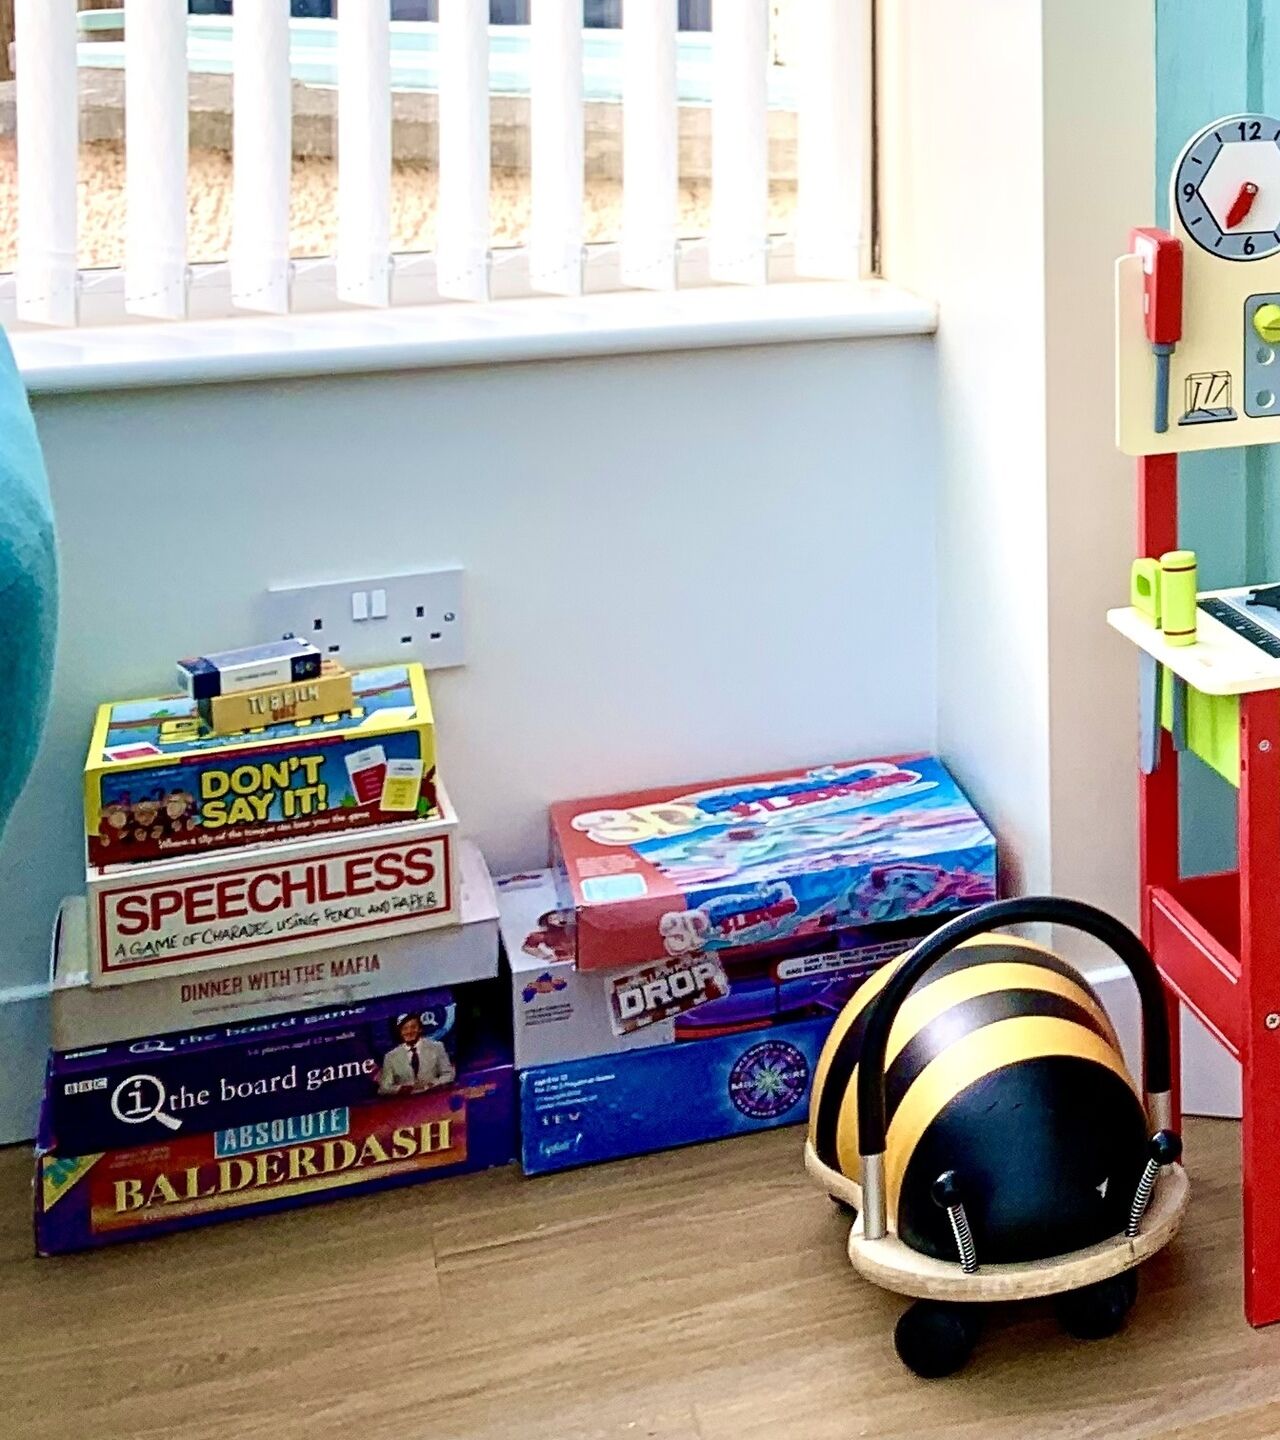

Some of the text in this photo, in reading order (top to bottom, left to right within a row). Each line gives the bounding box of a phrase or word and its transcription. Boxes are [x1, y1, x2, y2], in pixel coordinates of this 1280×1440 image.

[1238, 121, 1262, 141] 12
[1183, 183, 1195, 202] 9
[1243, 237, 1255, 255] 6
[202, 754, 325, 799] DON'T
[202, 783, 328, 829] SAY IT!
[115, 847, 435, 936] SPEECHLESS
[114, 942, 126, 958] A
[129, 935, 178, 957] GAME
[202, 920, 275, 946] CHARADES
[276, 911, 321, 933] USING
[323, 906, 366, 923] PENCIL
[368, 899, 390, 915] AND
[180, 953, 381, 1004] DINNER WITH THE MAFIA
[168, 1055, 376, 1111] the board game
[222, 1109, 342, 1152] ABSOLUTE
[113, 1118, 454, 1214] BALDERDASH
